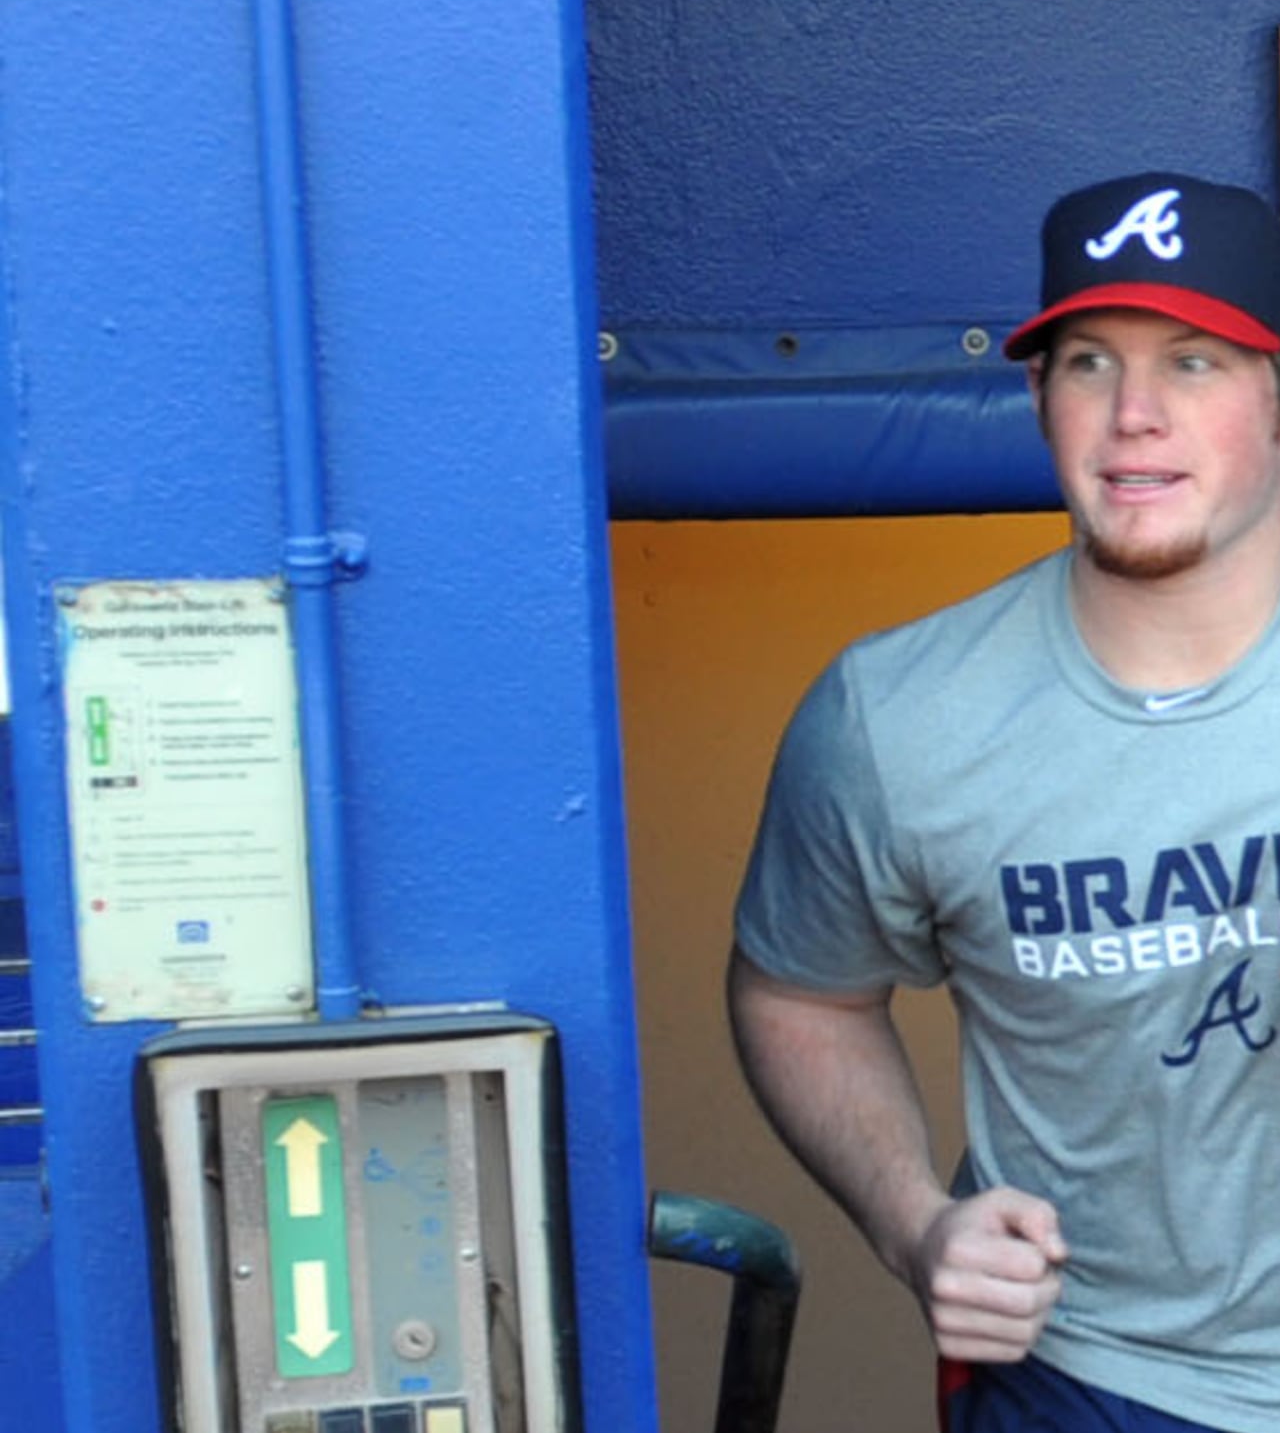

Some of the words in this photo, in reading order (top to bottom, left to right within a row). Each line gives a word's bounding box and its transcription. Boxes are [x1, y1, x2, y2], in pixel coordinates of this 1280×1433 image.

[1085, 188, 1183, 260] A
[72, 624, 165, 641] Operating
[170, 622, 278, 639] Instructions
[1160, 957, 1277, 1067] A
